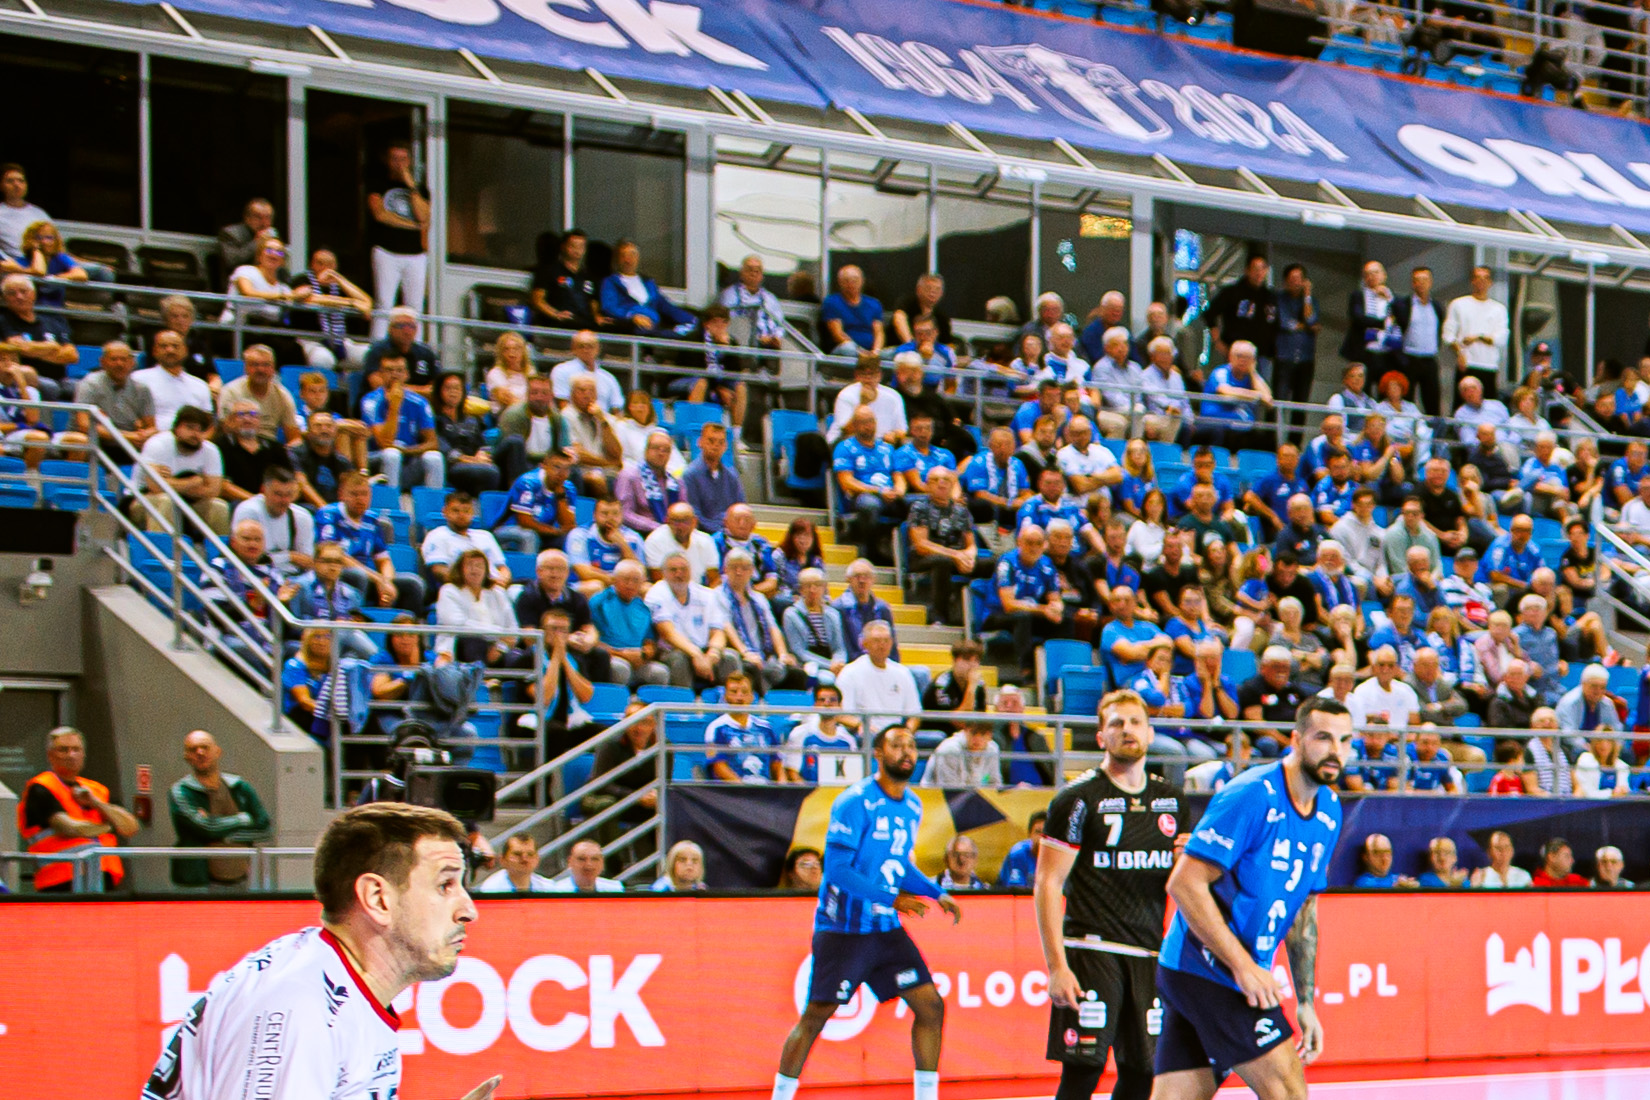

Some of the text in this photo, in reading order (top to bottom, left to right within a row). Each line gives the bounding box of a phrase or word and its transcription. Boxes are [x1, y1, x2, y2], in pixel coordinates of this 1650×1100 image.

[820, 26, 1042, 114] 1964
[1138, 78, 1350, 163] 2024
[1103, 813, 1124, 847] 7
[400, 953, 667, 1055] OCK
